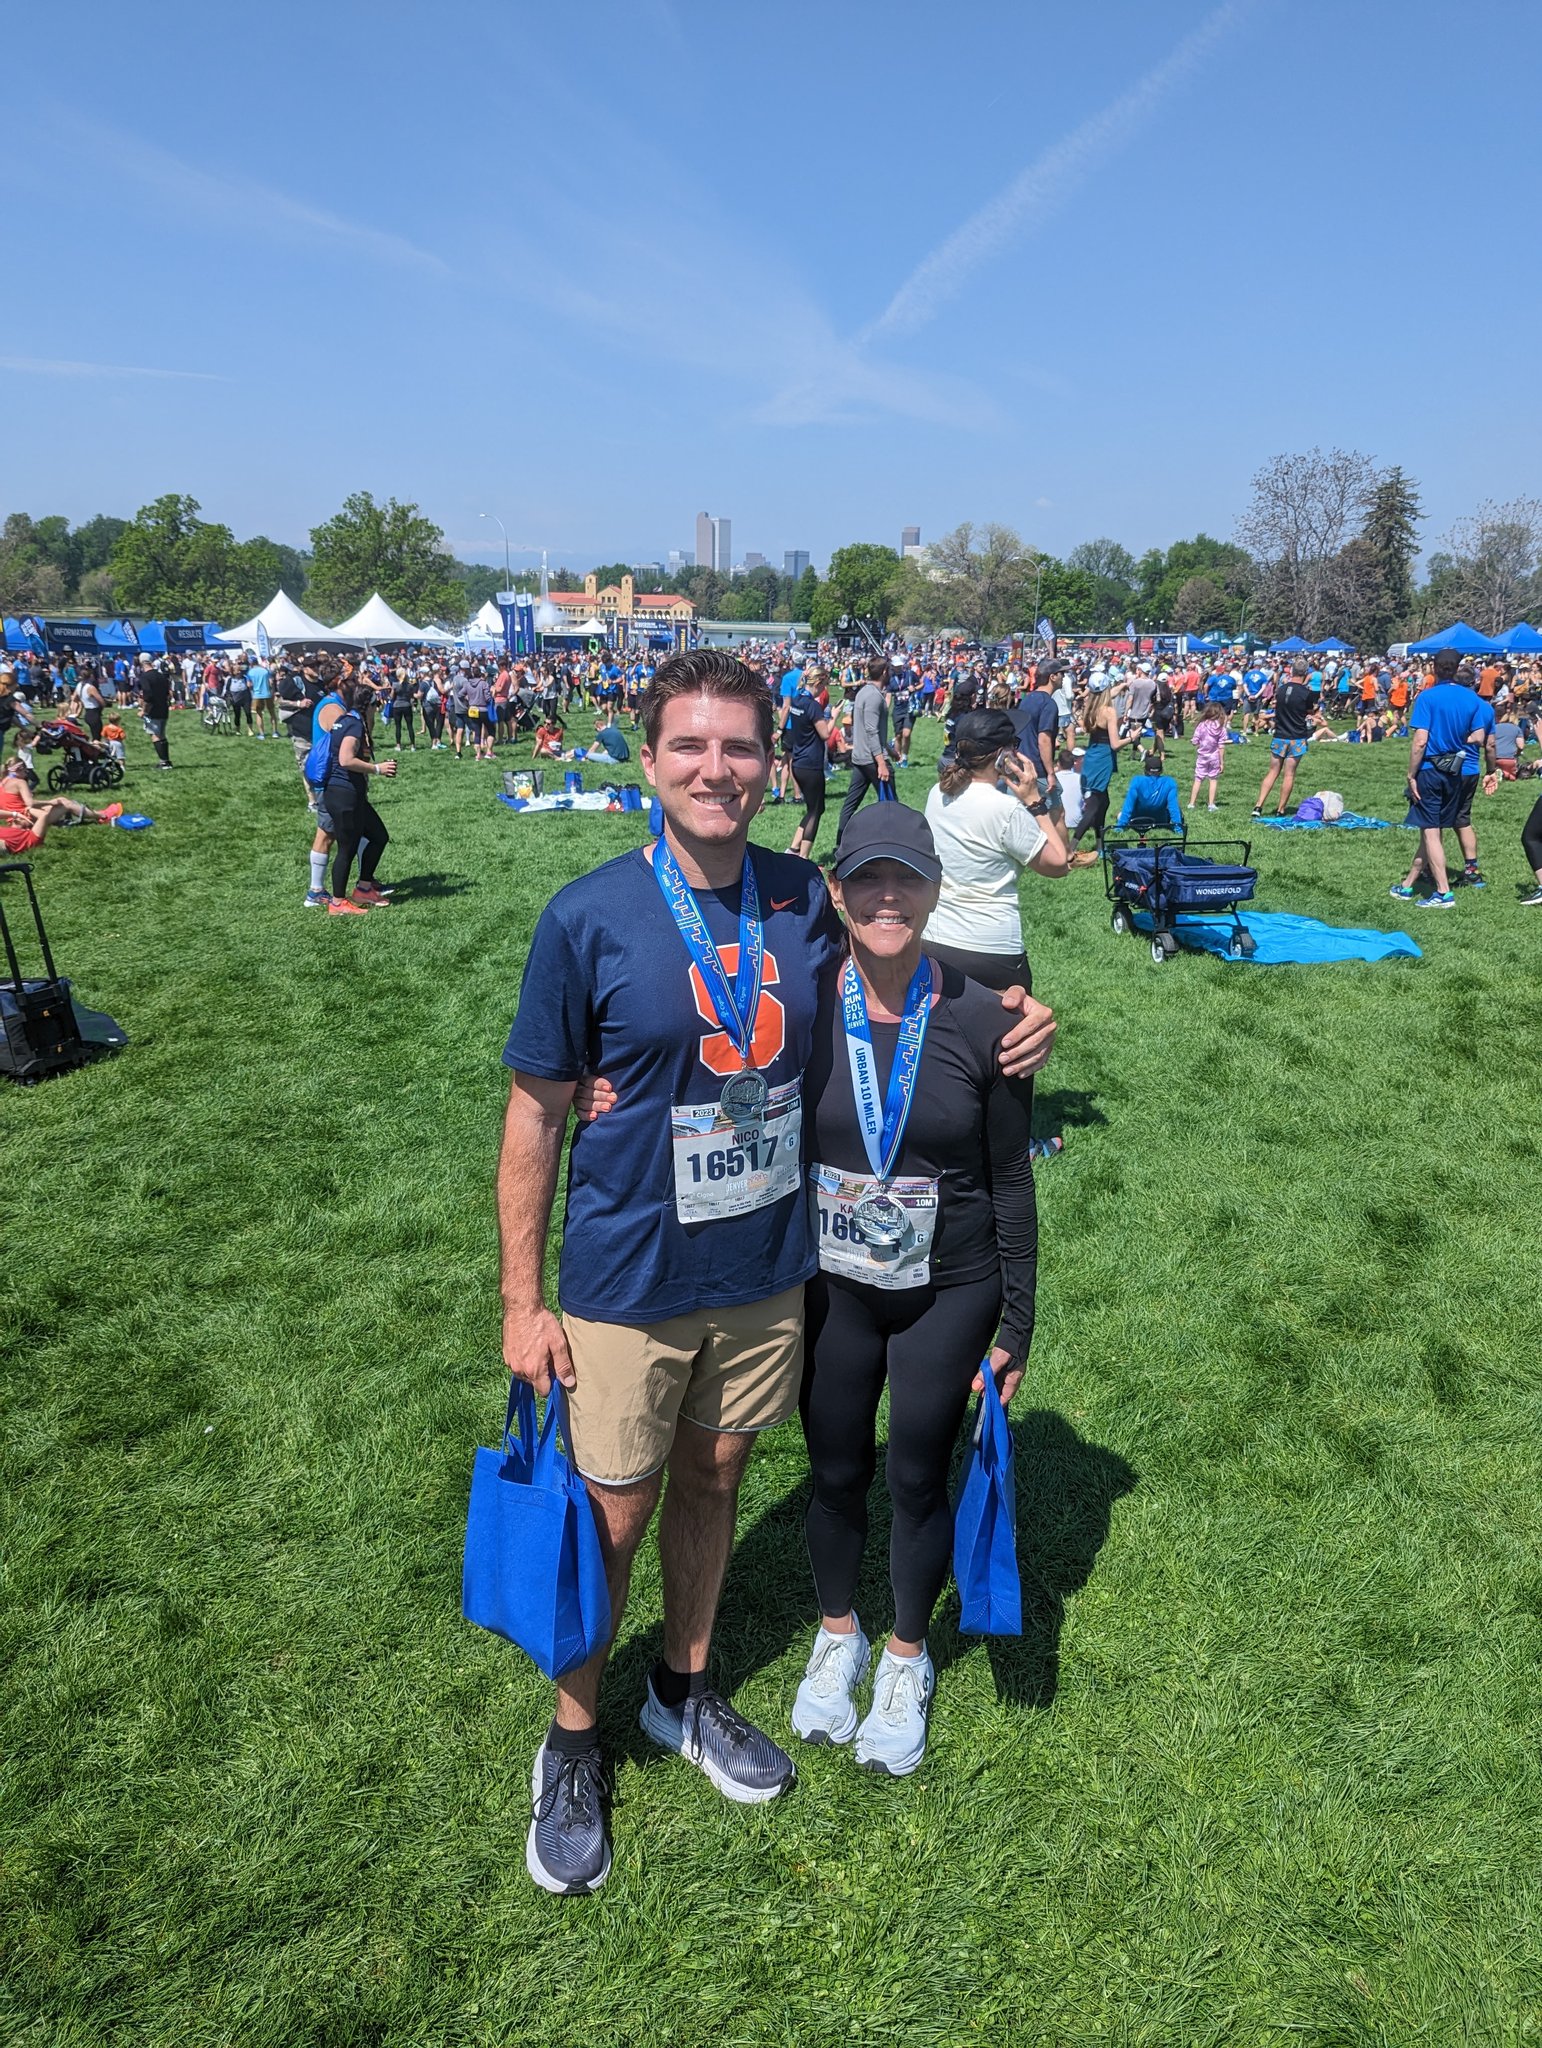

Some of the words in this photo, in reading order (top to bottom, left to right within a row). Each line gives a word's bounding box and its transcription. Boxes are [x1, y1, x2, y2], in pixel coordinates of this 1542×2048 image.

[53, 627, 94, 637] INFORMATION
[178, 629, 203, 639] RESULTS
[1195, 887, 1242, 896] WONDERFOLD
[845, 993, 861, 1006] RUN
[845, 1003, 863, 1014] COL
[846, 1010, 864, 1022] FAX
[847, 1019, 866, 1029] DENVER
[855, 1047, 870, 1085] URBAN
[861, 1085, 872, 1101] 10
[694, 1108, 714, 1117] 2023
[786, 1101, 800, 1113] 10M
[863, 1102, 877, 1136] MILER
[732, 1129, 760, 1146] NICO
[788, 1137, 794, 1148] G
[686, 1135, 779, 1183] 16517
[915, 1199, 933, 1207] 10M
[917, 1233, 924, 1243] G
